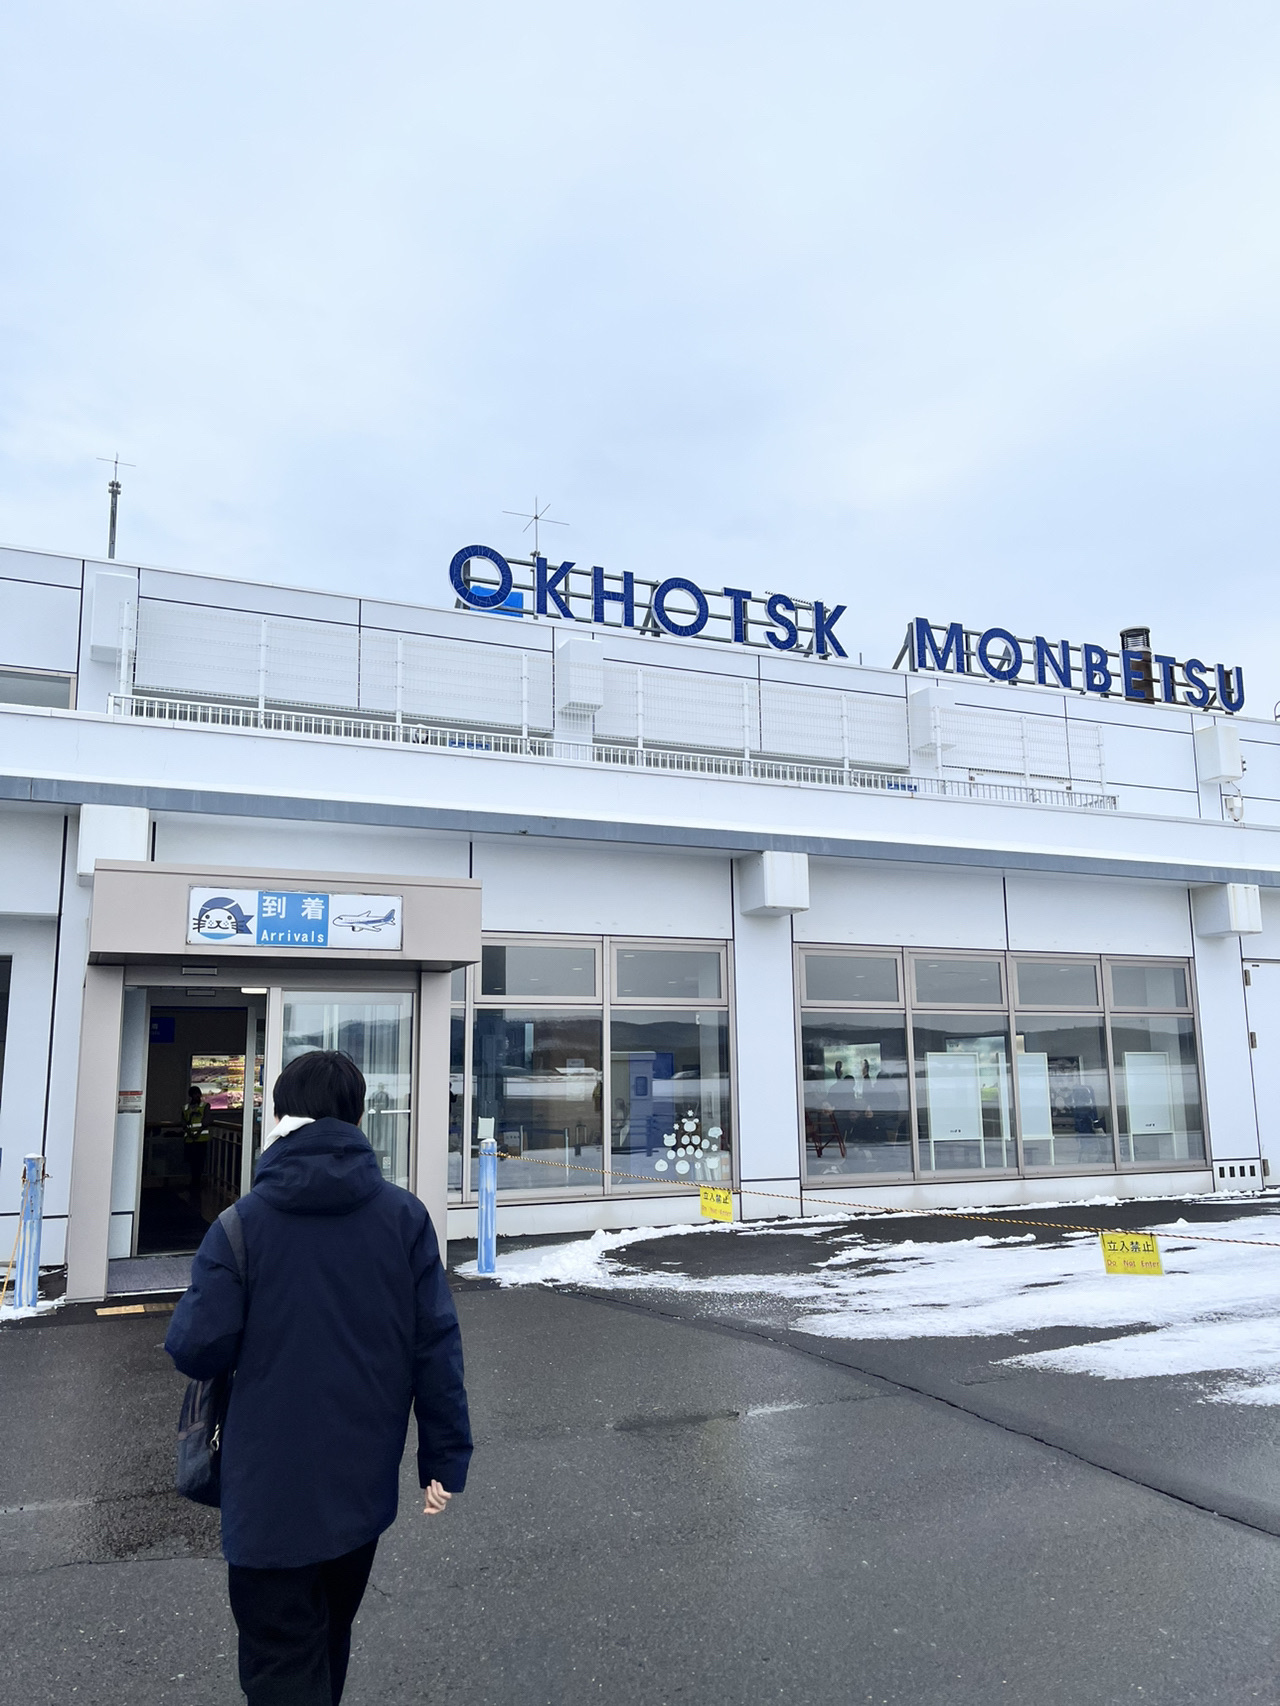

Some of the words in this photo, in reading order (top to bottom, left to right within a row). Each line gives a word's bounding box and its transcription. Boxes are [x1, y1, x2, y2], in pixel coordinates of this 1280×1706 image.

[449, 544, 848, 659] OKHOTSK
[913, 617, 1245, 713] MONBETSU
[262, 895, 325, 920] 到着
[261, 929, 325, 943] Arrivals
[1107, 1240, 1154, 1253] 立入禁止
[1107, 1259, 1116, 1267] Do
[1123, 1260, 1136, 1268] Not
[1141, 1260, 1159, 1268] Enter
